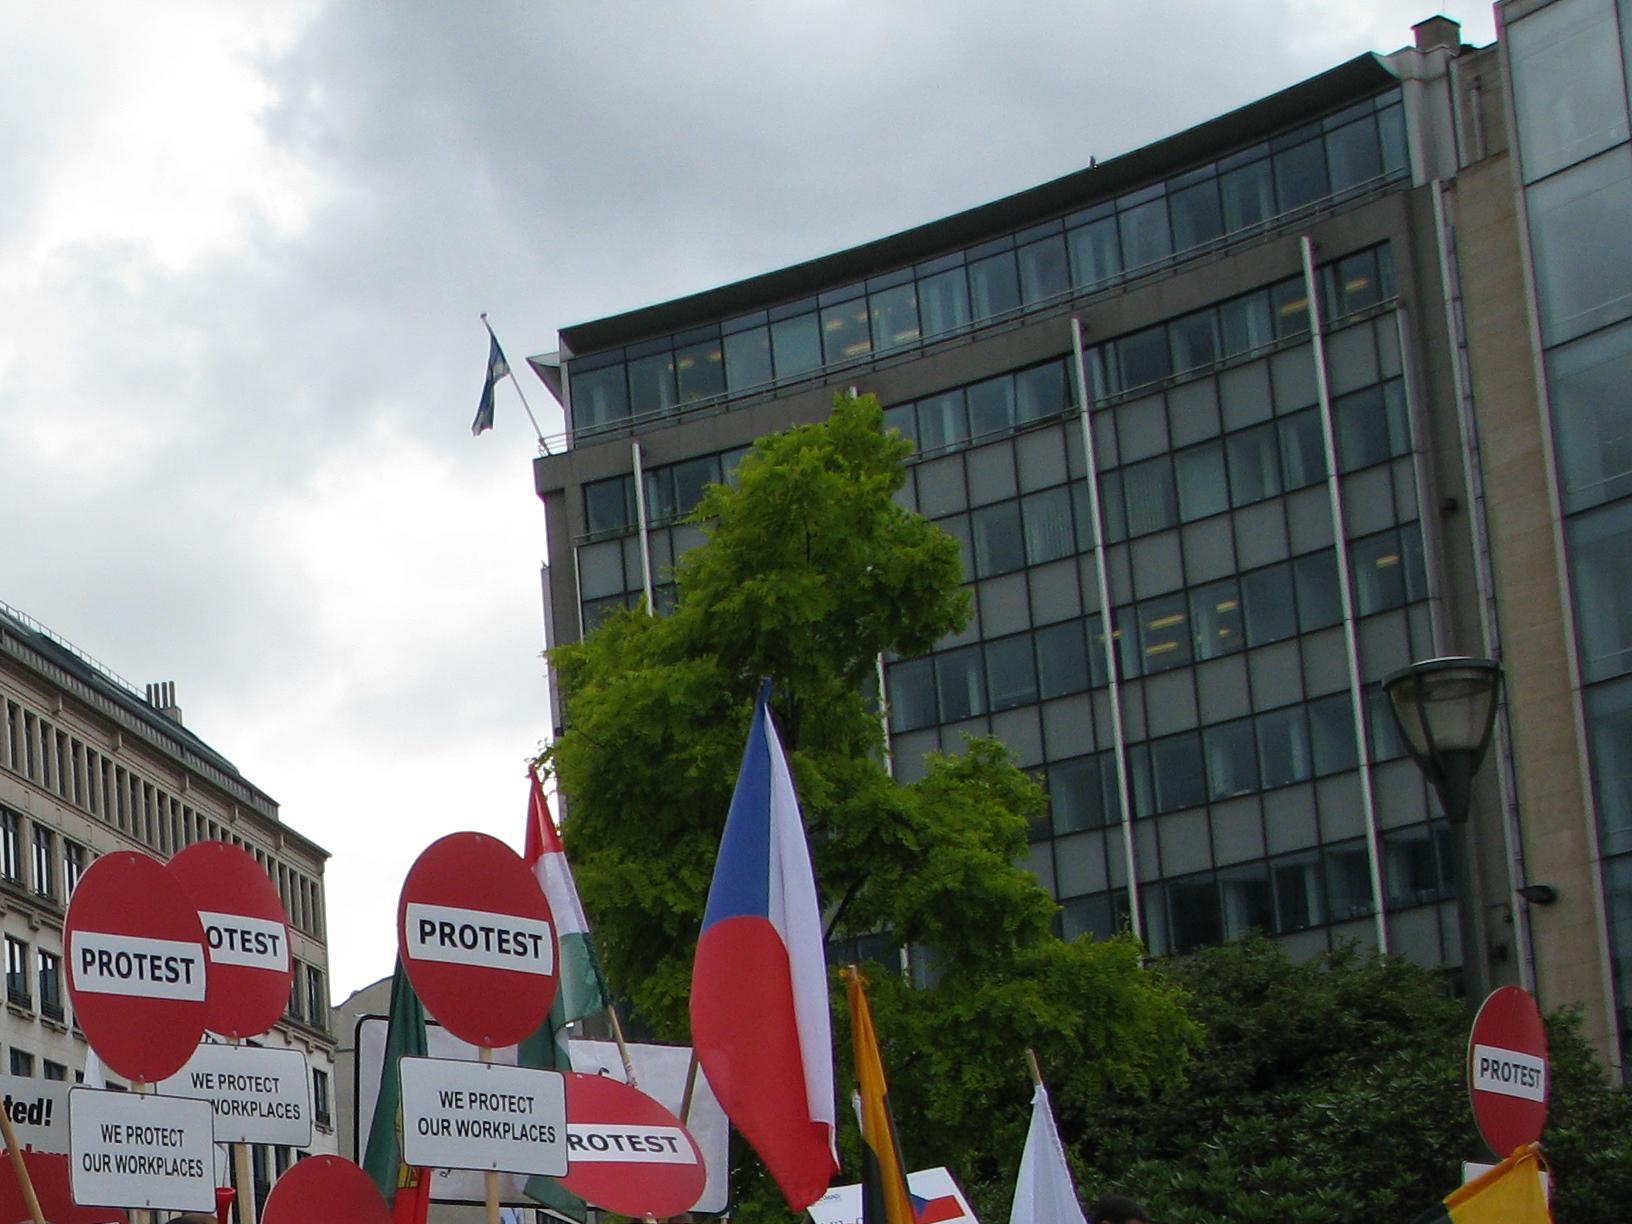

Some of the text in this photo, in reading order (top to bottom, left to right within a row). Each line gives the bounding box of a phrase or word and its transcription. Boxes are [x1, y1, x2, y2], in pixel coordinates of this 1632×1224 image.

[206, 925, 281, 957] OTEST
[418, 920, 543, 959] PROTEST
[81, 948, 195, 985] PROTEST
[191, 1072, 280, 1094] WE PROTECT
[1480, 1057, 1542, 1089] PROTEST
[439, 1091, 534, 1115] WE PROTECT
[101, 1124, 184, 1148] WE PROTECT
[418, 1117, 556, 1144] OUR WORKPLACES
[567, 1132, 679, 1155] ROTEST
[82, 1153, 204, 1178] OUR WORKPLACES
